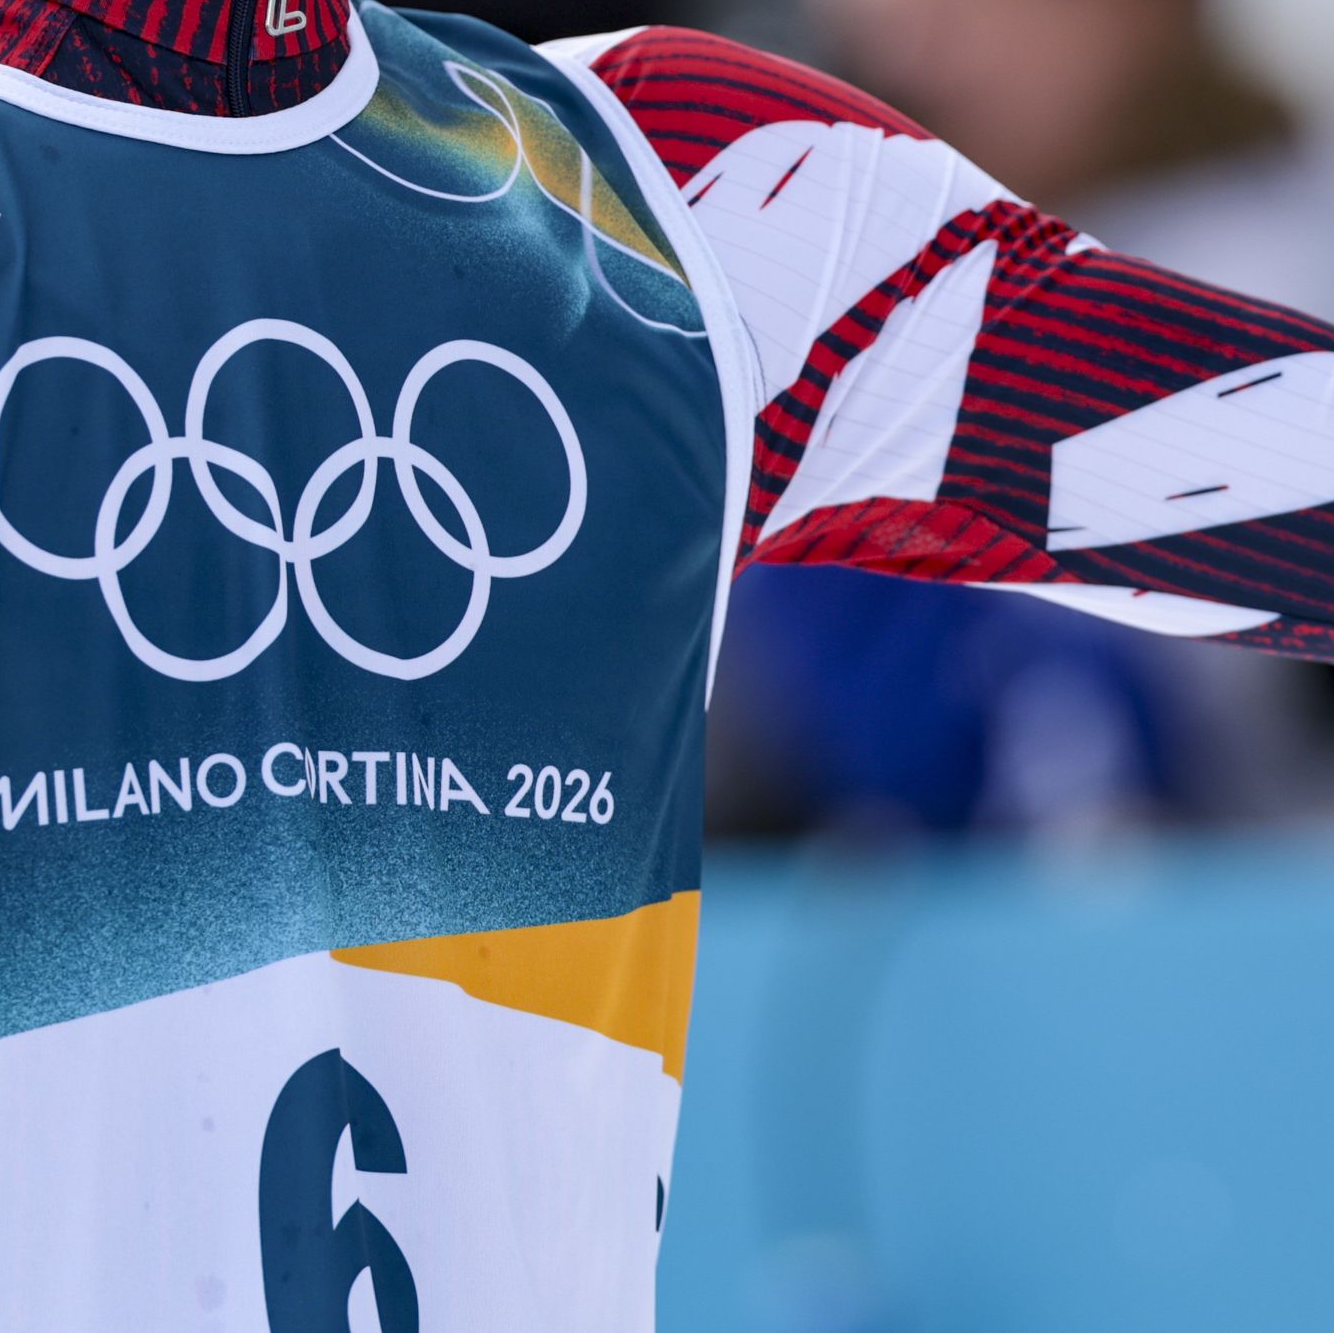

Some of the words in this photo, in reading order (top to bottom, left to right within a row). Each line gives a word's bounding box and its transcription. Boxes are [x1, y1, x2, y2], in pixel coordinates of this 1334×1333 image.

[261, 741, 491, 815] CORTINA
[504, 763, 614, 825] 2026
[258, 1048, 419, 1333] 6
